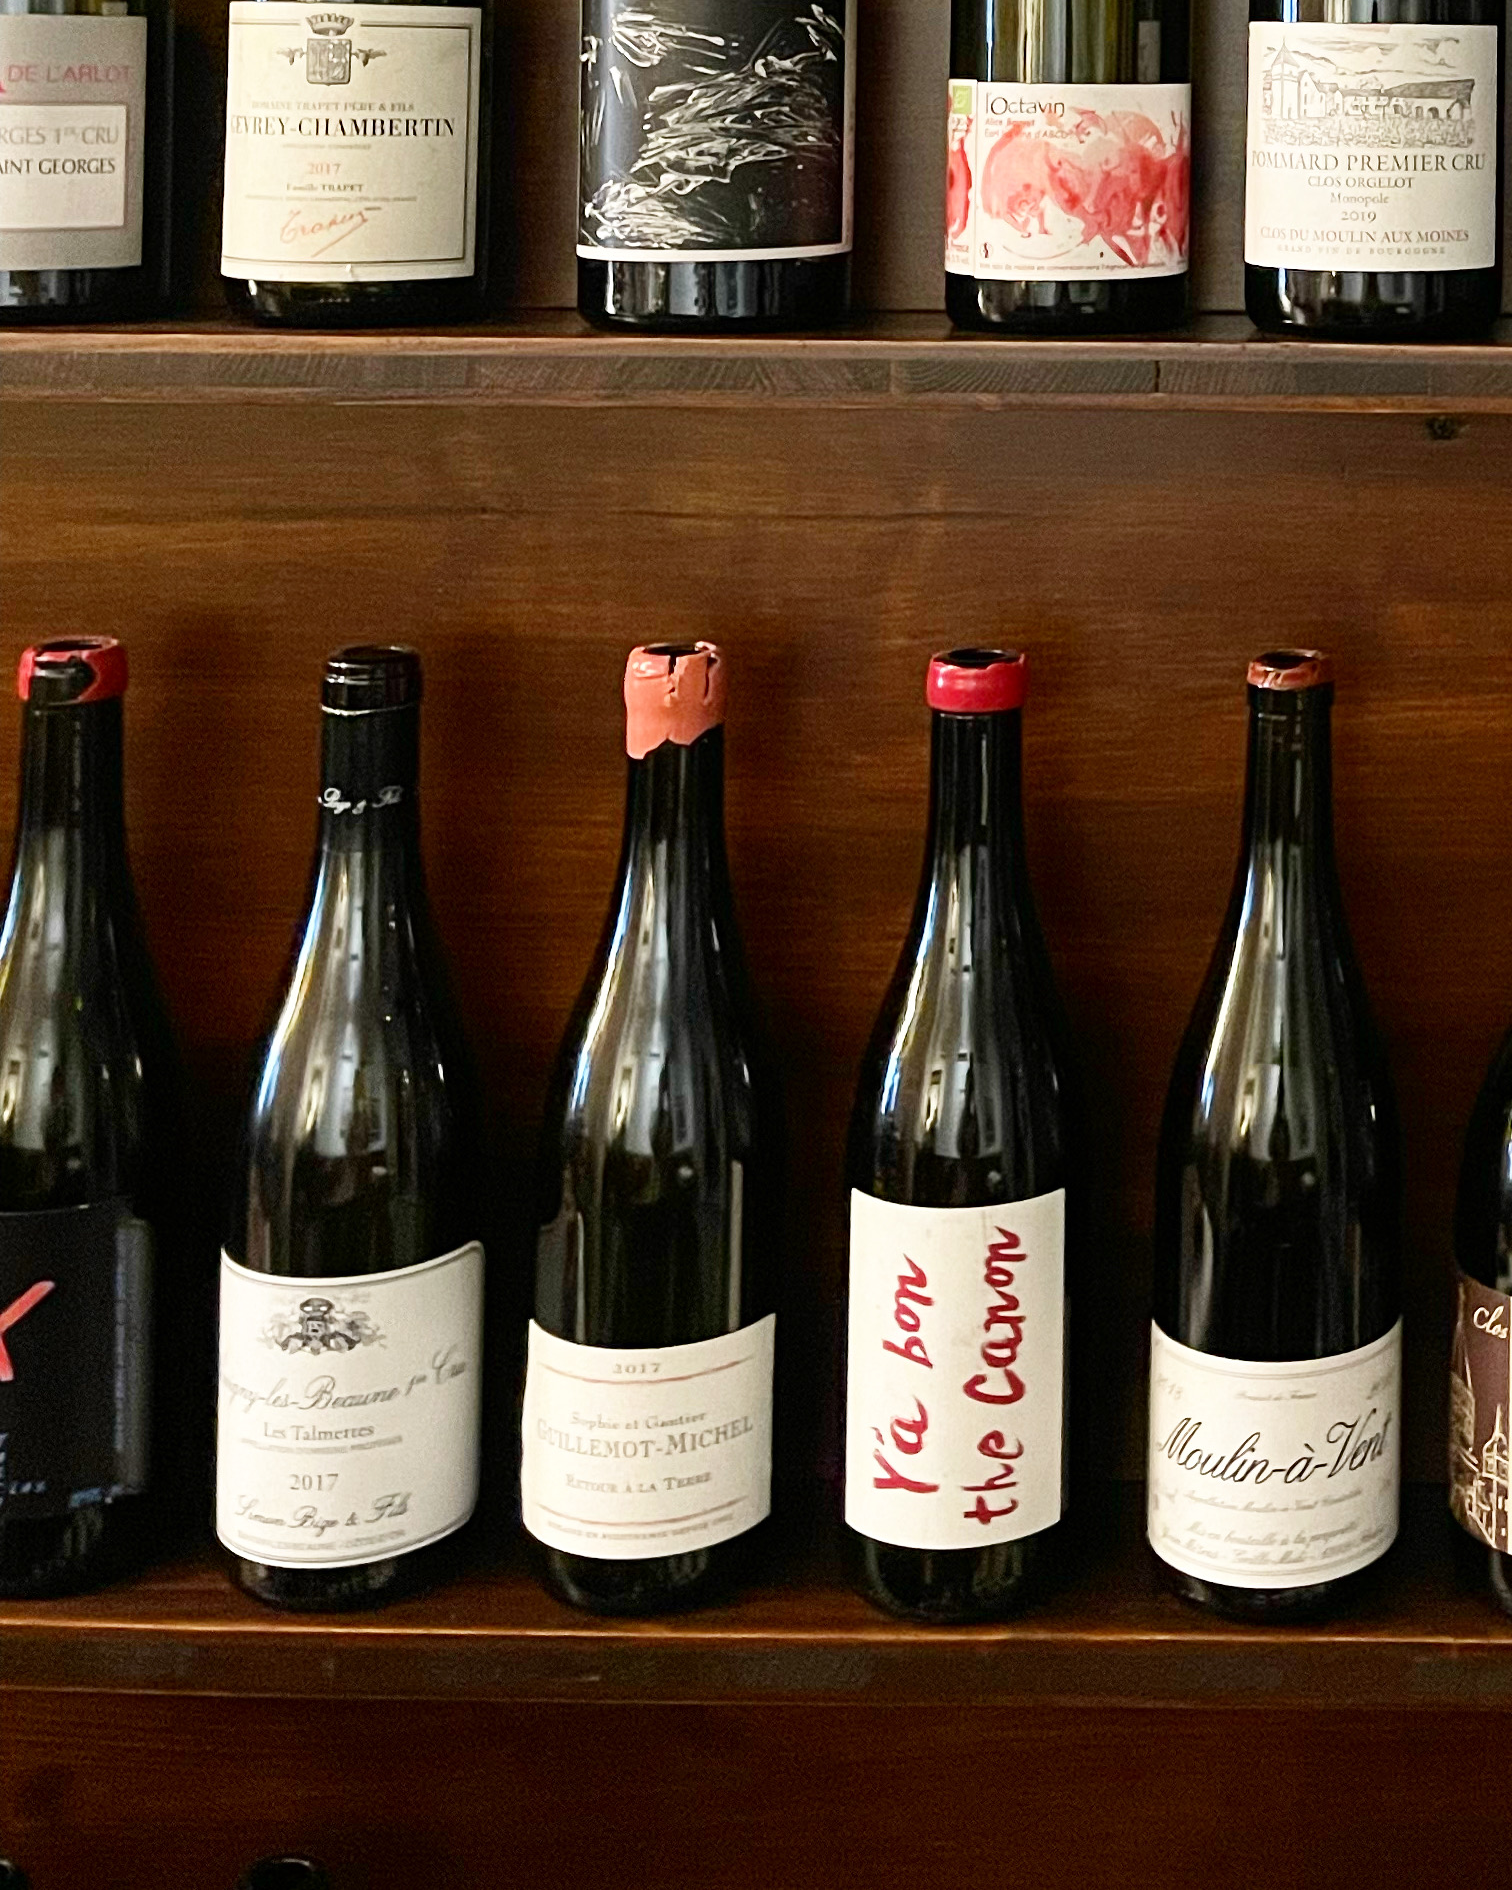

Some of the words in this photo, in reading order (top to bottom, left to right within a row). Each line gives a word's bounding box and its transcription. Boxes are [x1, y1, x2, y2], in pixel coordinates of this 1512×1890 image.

[81, 125, 119, 146] CRU
[38, 157, 116, 176] GEORGES
[308, 162, 342, 176] 2017
[1251, 150, 1339, 171] POMMARD
[1346, 153, 1449, 173] PREMIER
[1451, 153, 1485, 172] CRU
[1307, 175, 1342, 189] CLOS
[1345, 176, 1415, 190] ORGELOT
[1341, 209, 1377, 223] 2019
[1260, 226, 1286, 240] CLOS
[1289, 228, 1308, 241] DU
[1312, 229, 1376, 243] MOULIN
[1380, 230, 1413, 243] AUX
[1416, 229, 1469, 244] MOINES
[882, 1253, 935, 1370] bon
[963, 1225, 1028, 1405] Canon
[1472, 1305, 1509, 1340] Clos
[535, 1416, 754, 1460] GUILLEMOT-MICHEL
[1156, 1407, 1393, 1485] Moulin-à-Vent
[289, 1473, 339, 1492] 2017
[960, 1429, 1024, 1525] the
